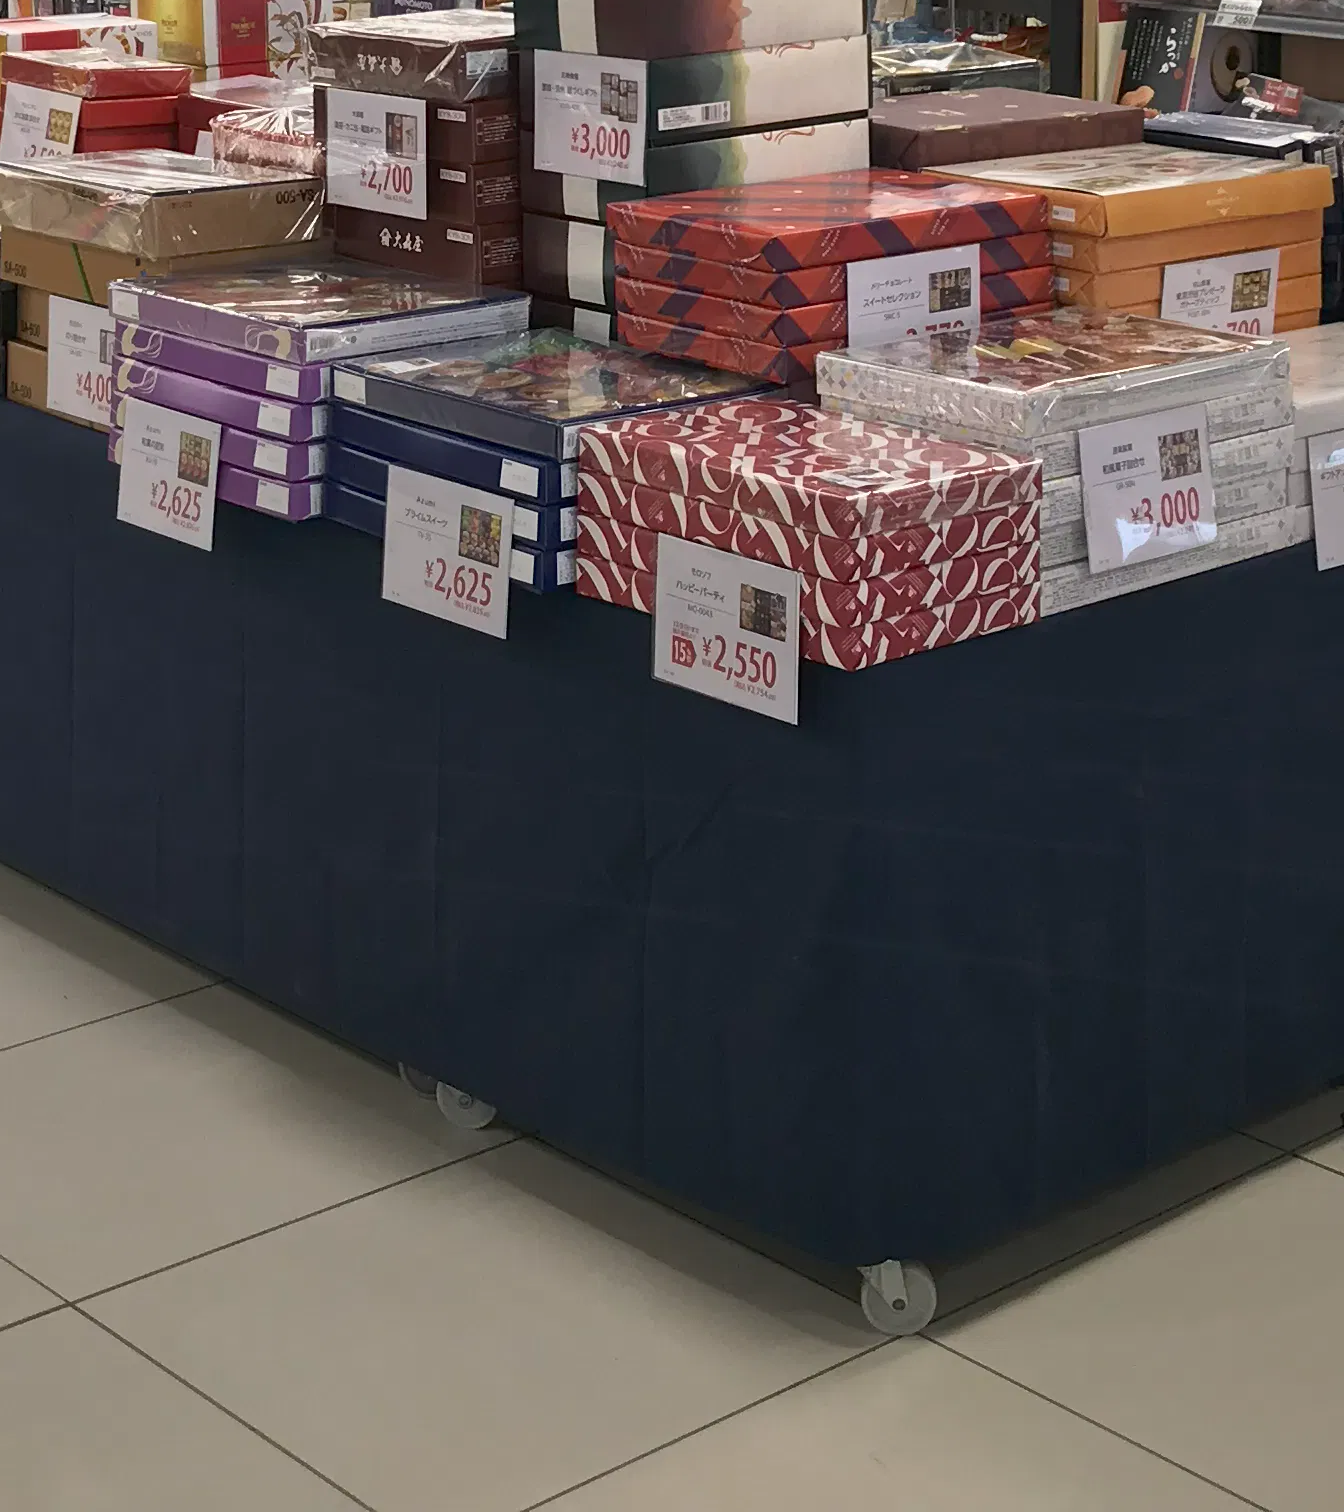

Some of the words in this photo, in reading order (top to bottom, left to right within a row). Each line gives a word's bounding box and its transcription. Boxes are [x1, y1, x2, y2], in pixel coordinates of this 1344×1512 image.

[571, 123, 631, 161] ¥3,000
[360, 159, 413, 196] ¥2,700
[863, 290, 921, 308] スイートセレクション
[76, 370, 112, 404] ¥4,00
[151, 480, 203, 522] ¥2,625
[404, 508, 448, 528] プライムスイーツ
[416, 496, 436, 507] Azumi
[1131, 487, 1199, 536] ¥3,000
[425, 557, 493, 606] ¥2,625
[675, 580, 726, 603] ハッピーパーティ
[702, 635, 777, 688] ¥2,550
